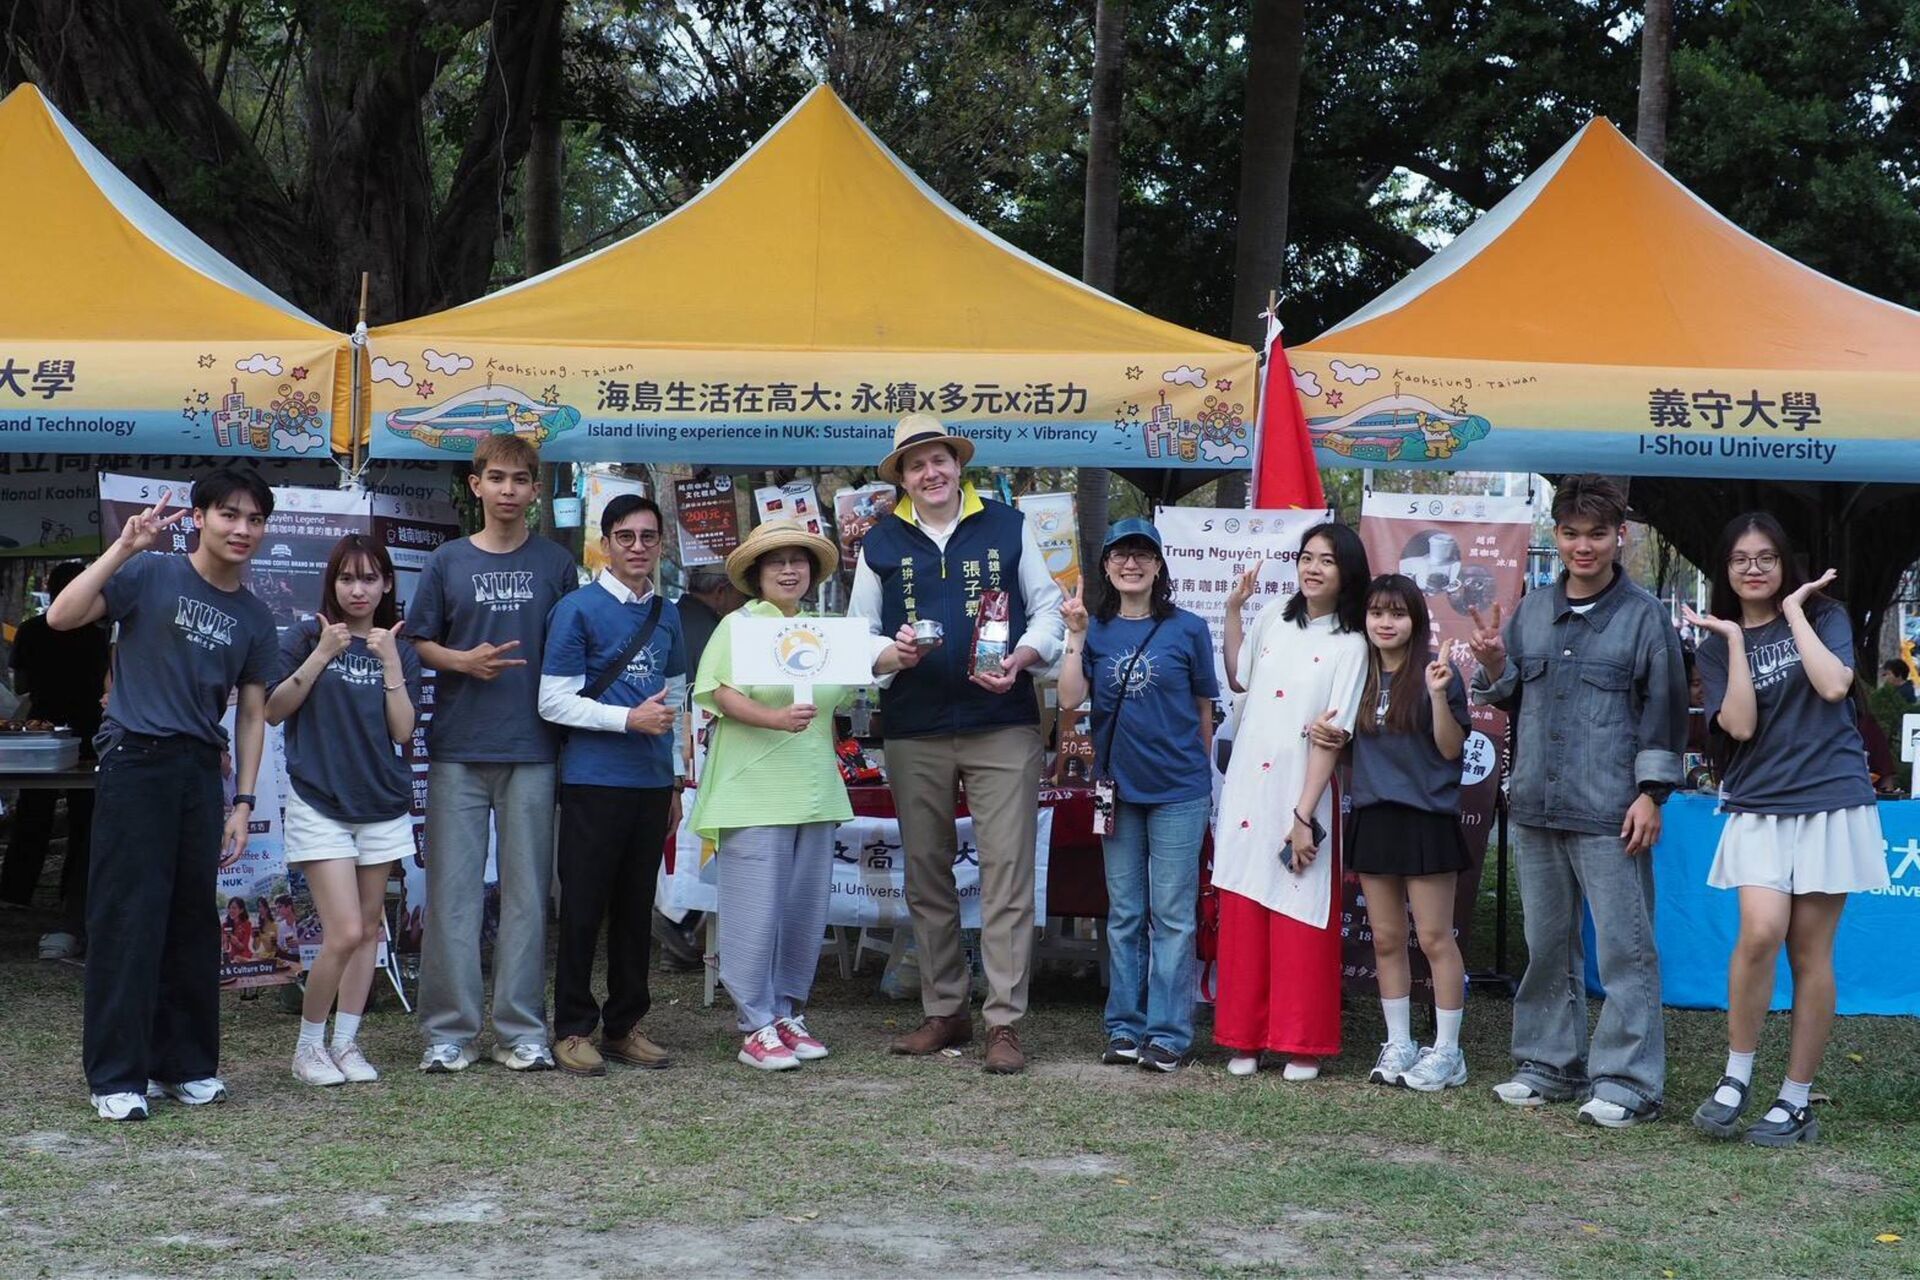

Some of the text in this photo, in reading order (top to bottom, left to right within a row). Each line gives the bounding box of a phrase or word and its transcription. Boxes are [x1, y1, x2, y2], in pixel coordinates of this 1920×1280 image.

[0, 358, 75, 399] 大學
[581, 362, 634, 378] Taiwan
[1486, 375, 1538, 389] Taiwan
[1648, 388, 1822, 432] 義守大學
[0, 416, 136, 436] and Technology
[587, 423, 633, 437] Island
[636, 424, 677, 440] living
[680, 425, 762, 440] experience
[765, 424, 778, 438] in
[782, 426, 820, 438] NUK:
[947, 426, 1012, 441] Diversity
[1034, 426, 1098, 443] Vibrancy
[1639, 434, 1837, 465] I-Shou University
[295, 514, 326, 525] Legend
[1164, 545, 1205, 561] Trung
[1208, 546, 1261, 561] Nguyên
[472, 571, 533, 602] NUK
[174, 595, 238, 646] NUK
[1061, 741, 1093, 755] 50元
[222, 878, 243, 887] NUK
[233, 965, 258, 975] Culture
[260, 963, 273, 972] Day
